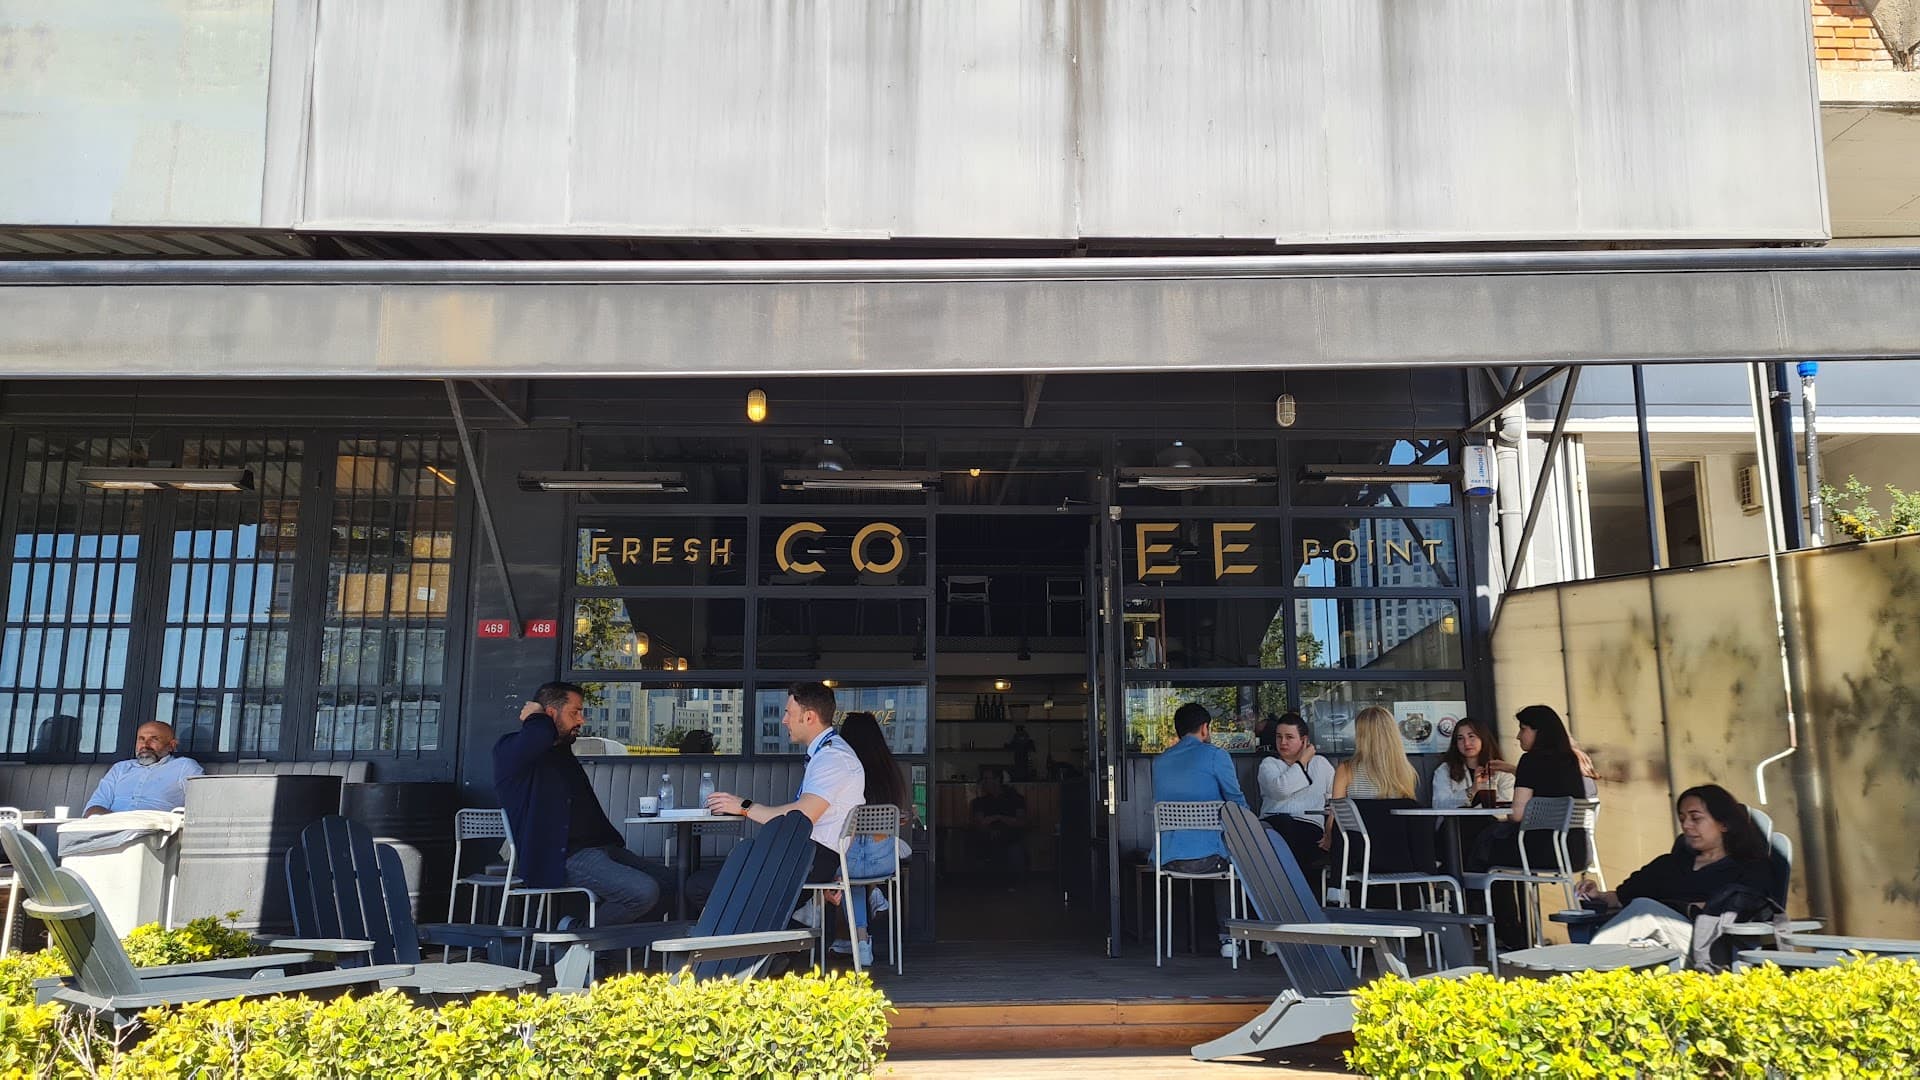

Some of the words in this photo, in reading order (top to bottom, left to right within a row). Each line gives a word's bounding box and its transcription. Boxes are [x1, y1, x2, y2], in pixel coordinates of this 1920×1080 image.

[591, 537, 732, 565] FRESH
[1302, 538, 1443, 566] POINT
[532, 623, 550, 633] 468
